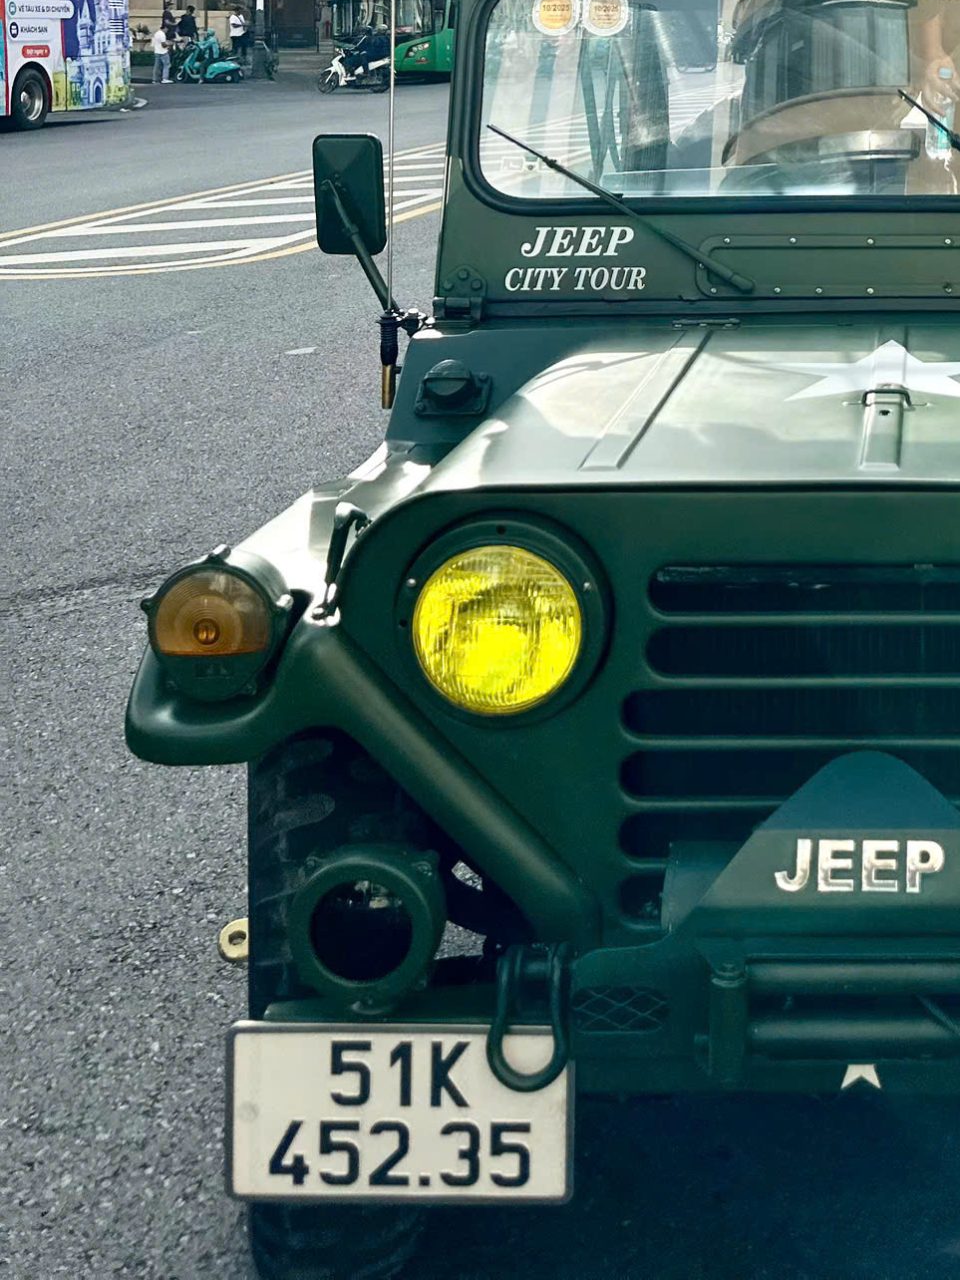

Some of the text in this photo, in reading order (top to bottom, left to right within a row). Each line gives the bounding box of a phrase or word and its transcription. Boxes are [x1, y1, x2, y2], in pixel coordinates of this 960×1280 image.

[520, 226, 635, 258] JEEP
[504, 266, 647, 292] CITY TOUR
[774, 838, 945, 893] JEEP
[330, 1040, 471, 1108] 51K
[268, 1120, 532, 1188] 452.35
